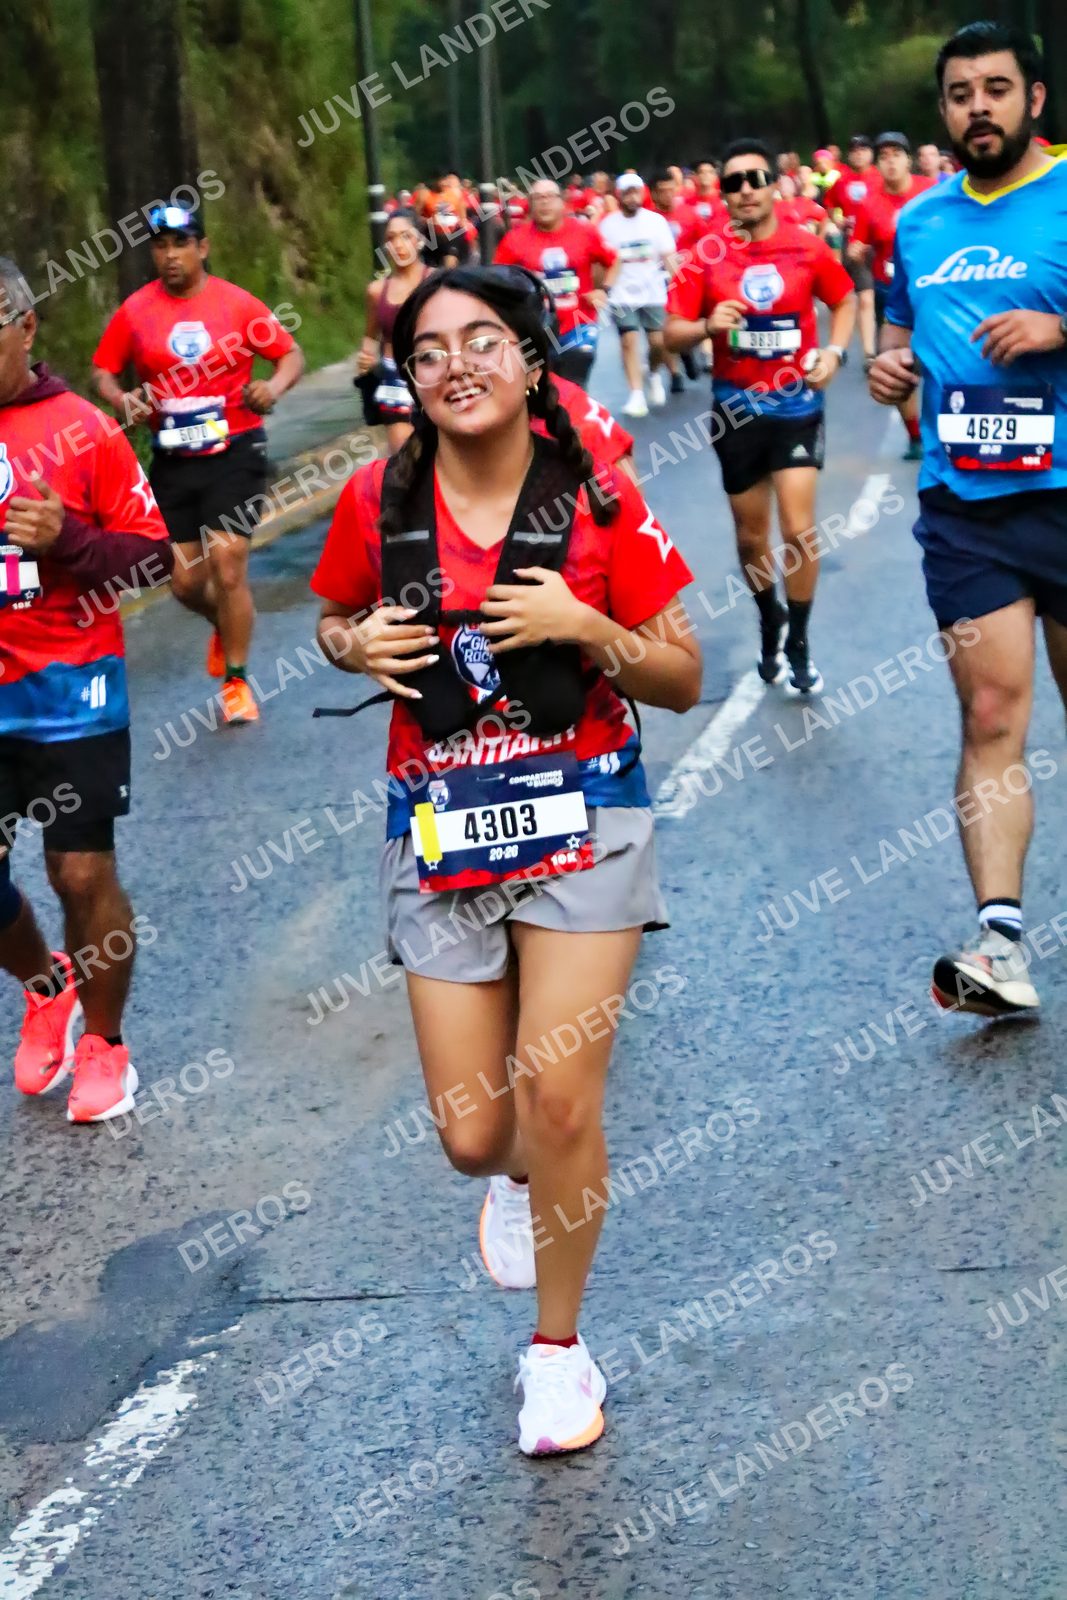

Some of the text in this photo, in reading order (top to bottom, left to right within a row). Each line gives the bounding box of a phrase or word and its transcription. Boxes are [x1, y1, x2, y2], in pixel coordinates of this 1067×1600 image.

[915, 246, 1028, 288] Linde
[966, 417, 1017, 441] 4629
[464, 803, 538, 844] 4303
[550, 852, 578, 866] 10K
